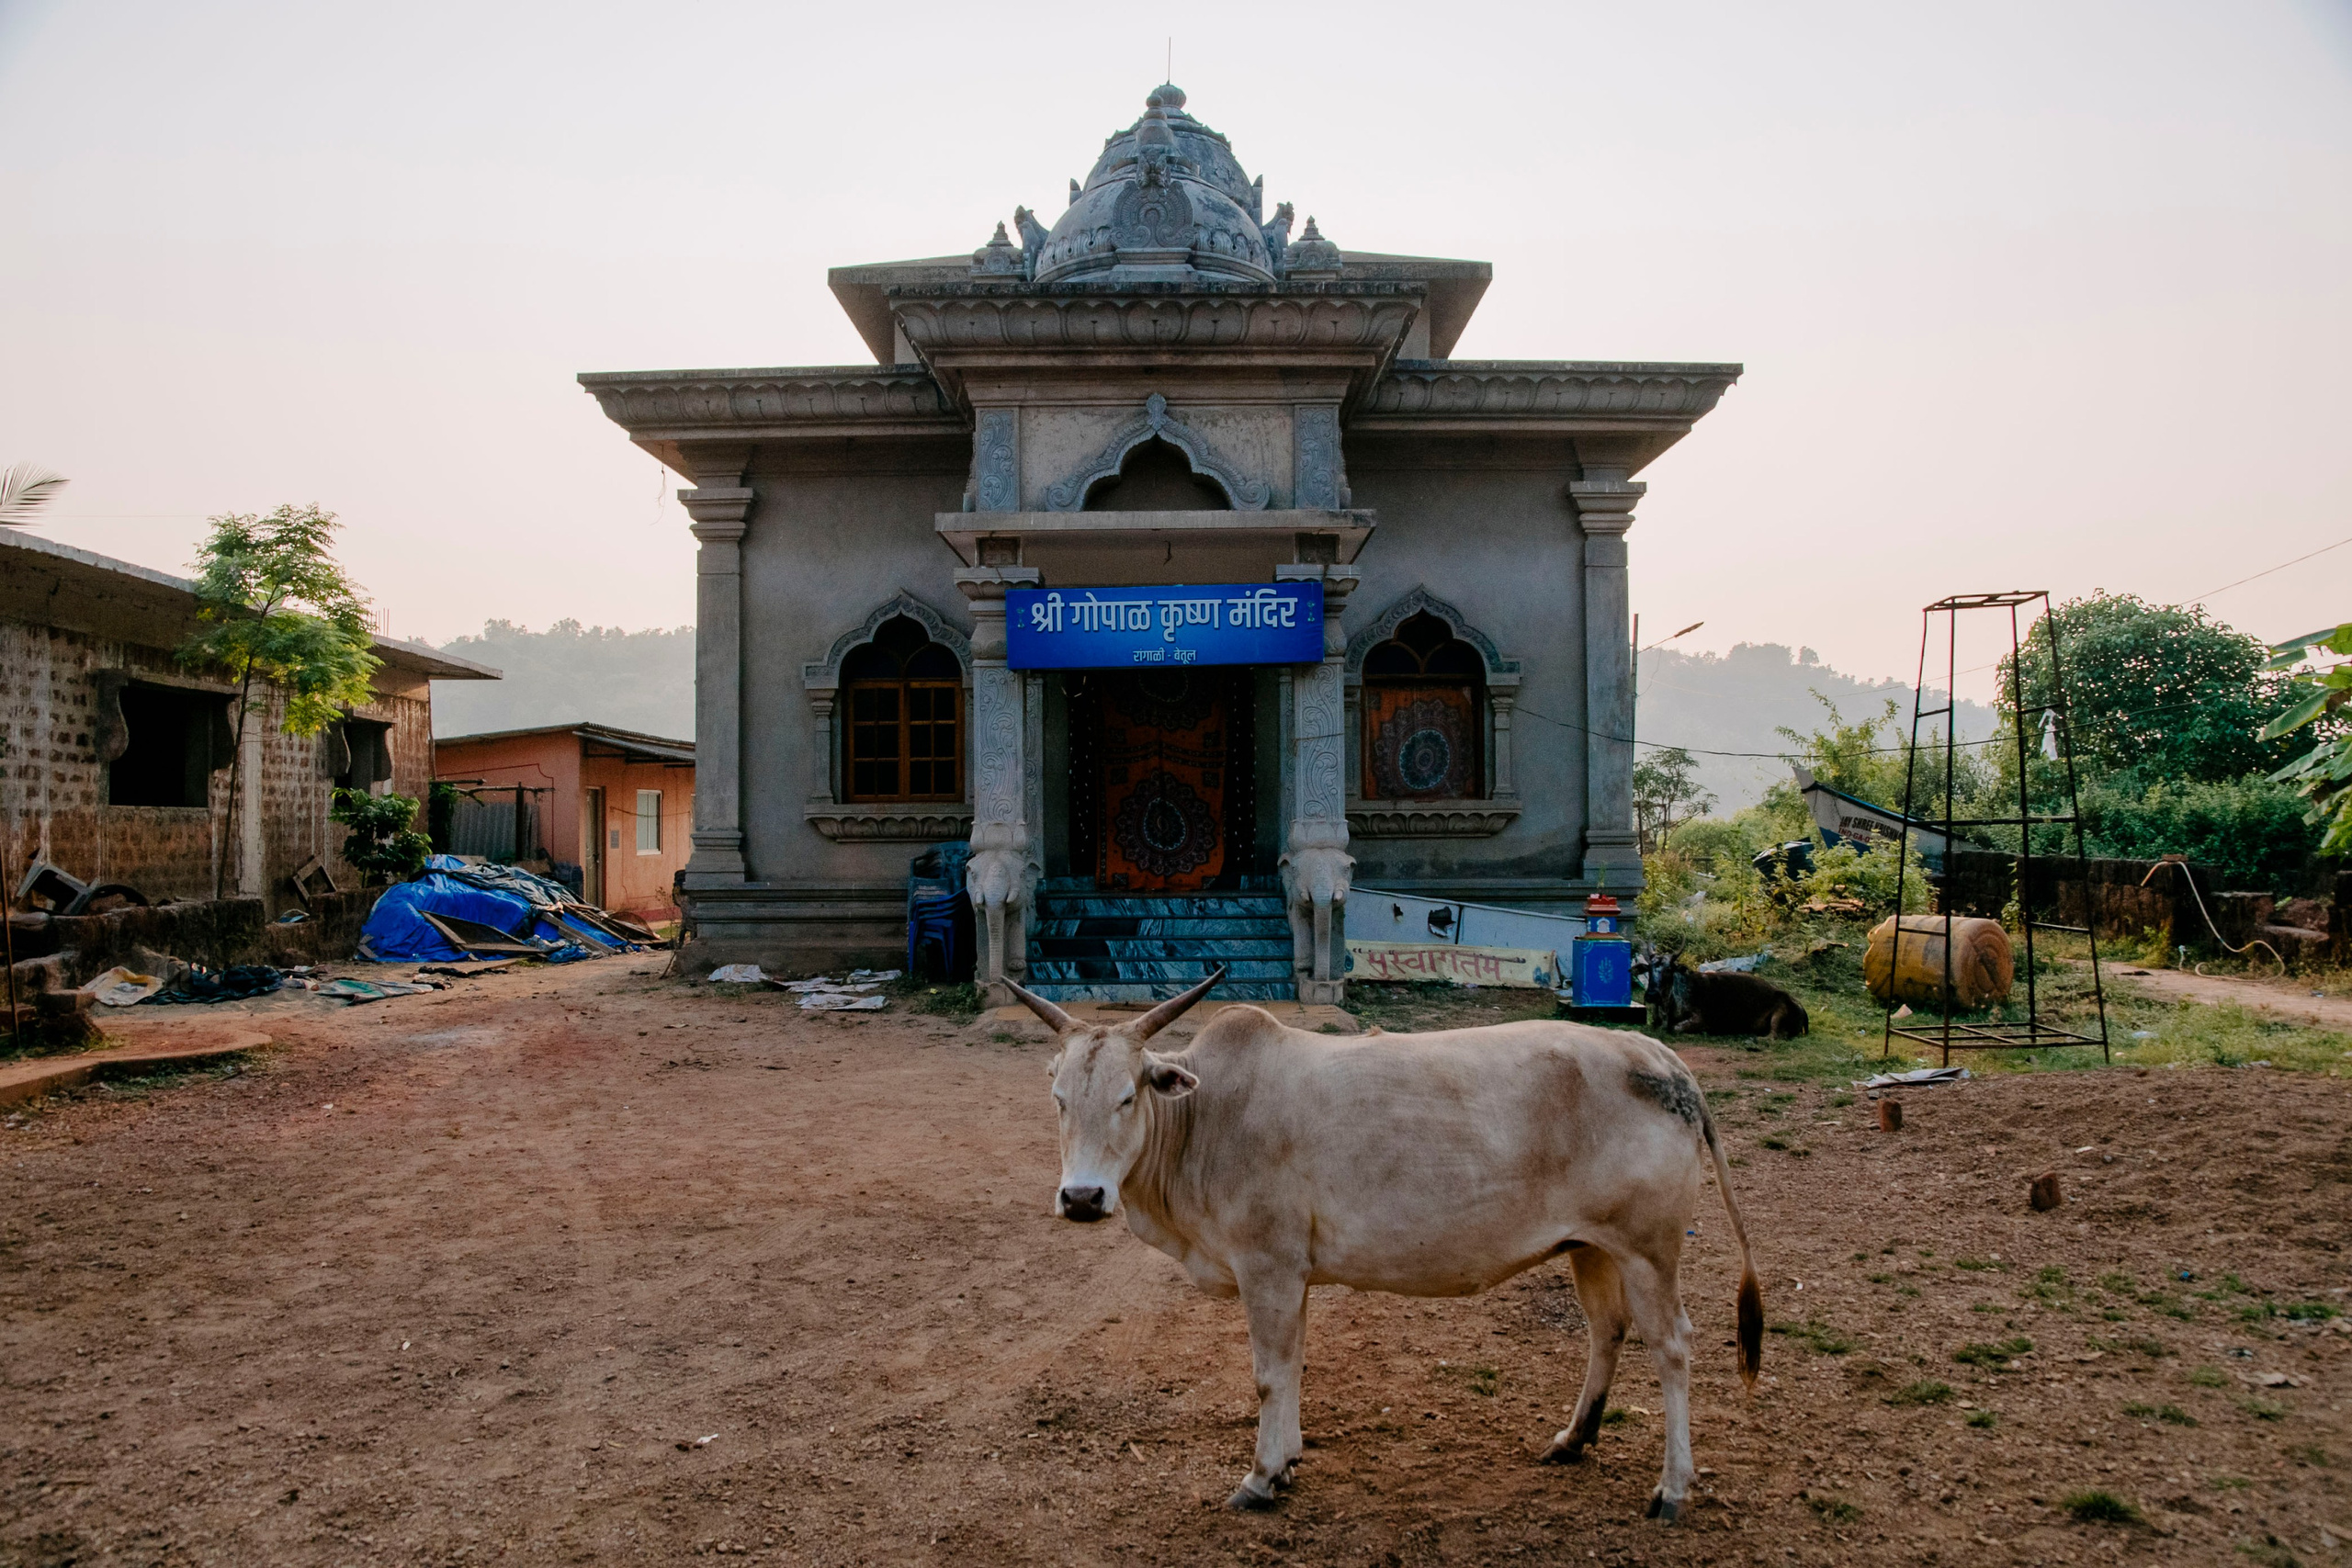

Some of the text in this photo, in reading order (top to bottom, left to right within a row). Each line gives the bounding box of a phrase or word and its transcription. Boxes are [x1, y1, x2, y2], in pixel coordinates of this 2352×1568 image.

[1031, 588, 1298, 642] श्री गोपाळ कृष्ण मंदिर
[1173, 645, 1196, 664] बेतूल
[1852, 817, 1875, 832] SHREE
